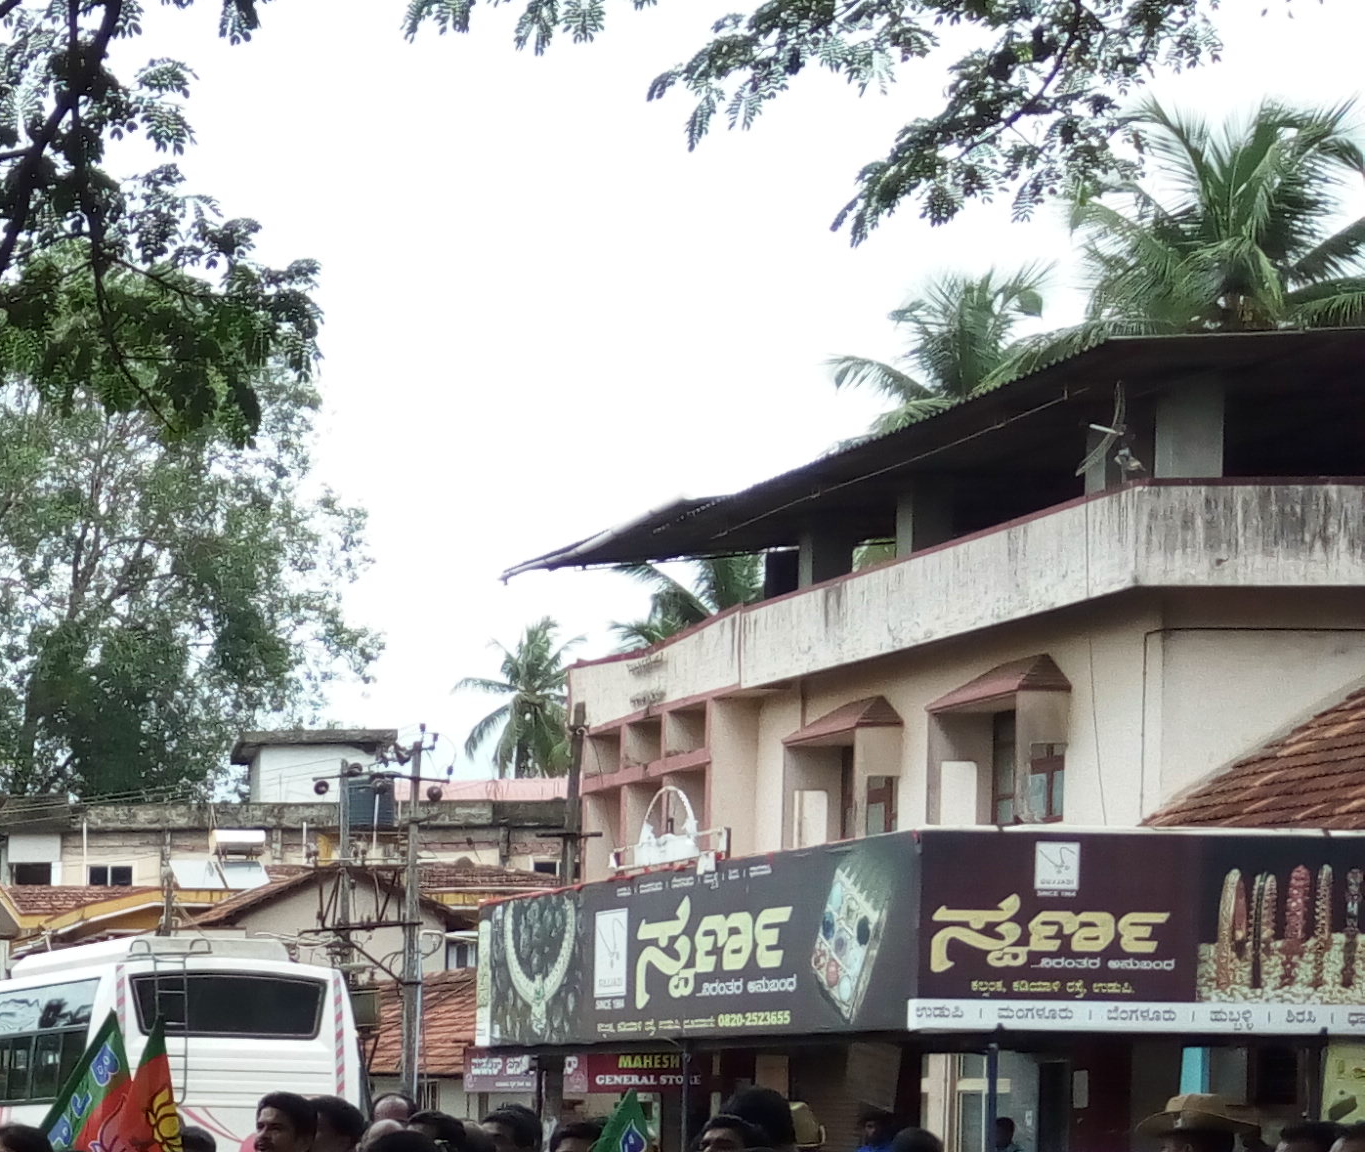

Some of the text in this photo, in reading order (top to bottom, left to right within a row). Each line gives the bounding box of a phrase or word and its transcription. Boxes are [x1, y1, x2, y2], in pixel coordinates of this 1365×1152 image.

[717, 1010, 791, 1028] 0820-2523655
[915, 1005, 964, 1019] ಉಡುಪಿ
[997, 1006, 1074, 1020] ಮಂಗಳೂರು
[1106, 1005, 1177, 1021] ಬೆಂಗಳೂರು
[1210, 1008, 1255, 1031] ಹುಬ್ಬಳ್ಳಿ
[1285, 1009, 1317, 1024] ಶಿರಸಿ
[618, 1054, 681, 1070] MAHESH
[595, 1074, 702, 1086] GENERAL STOE
